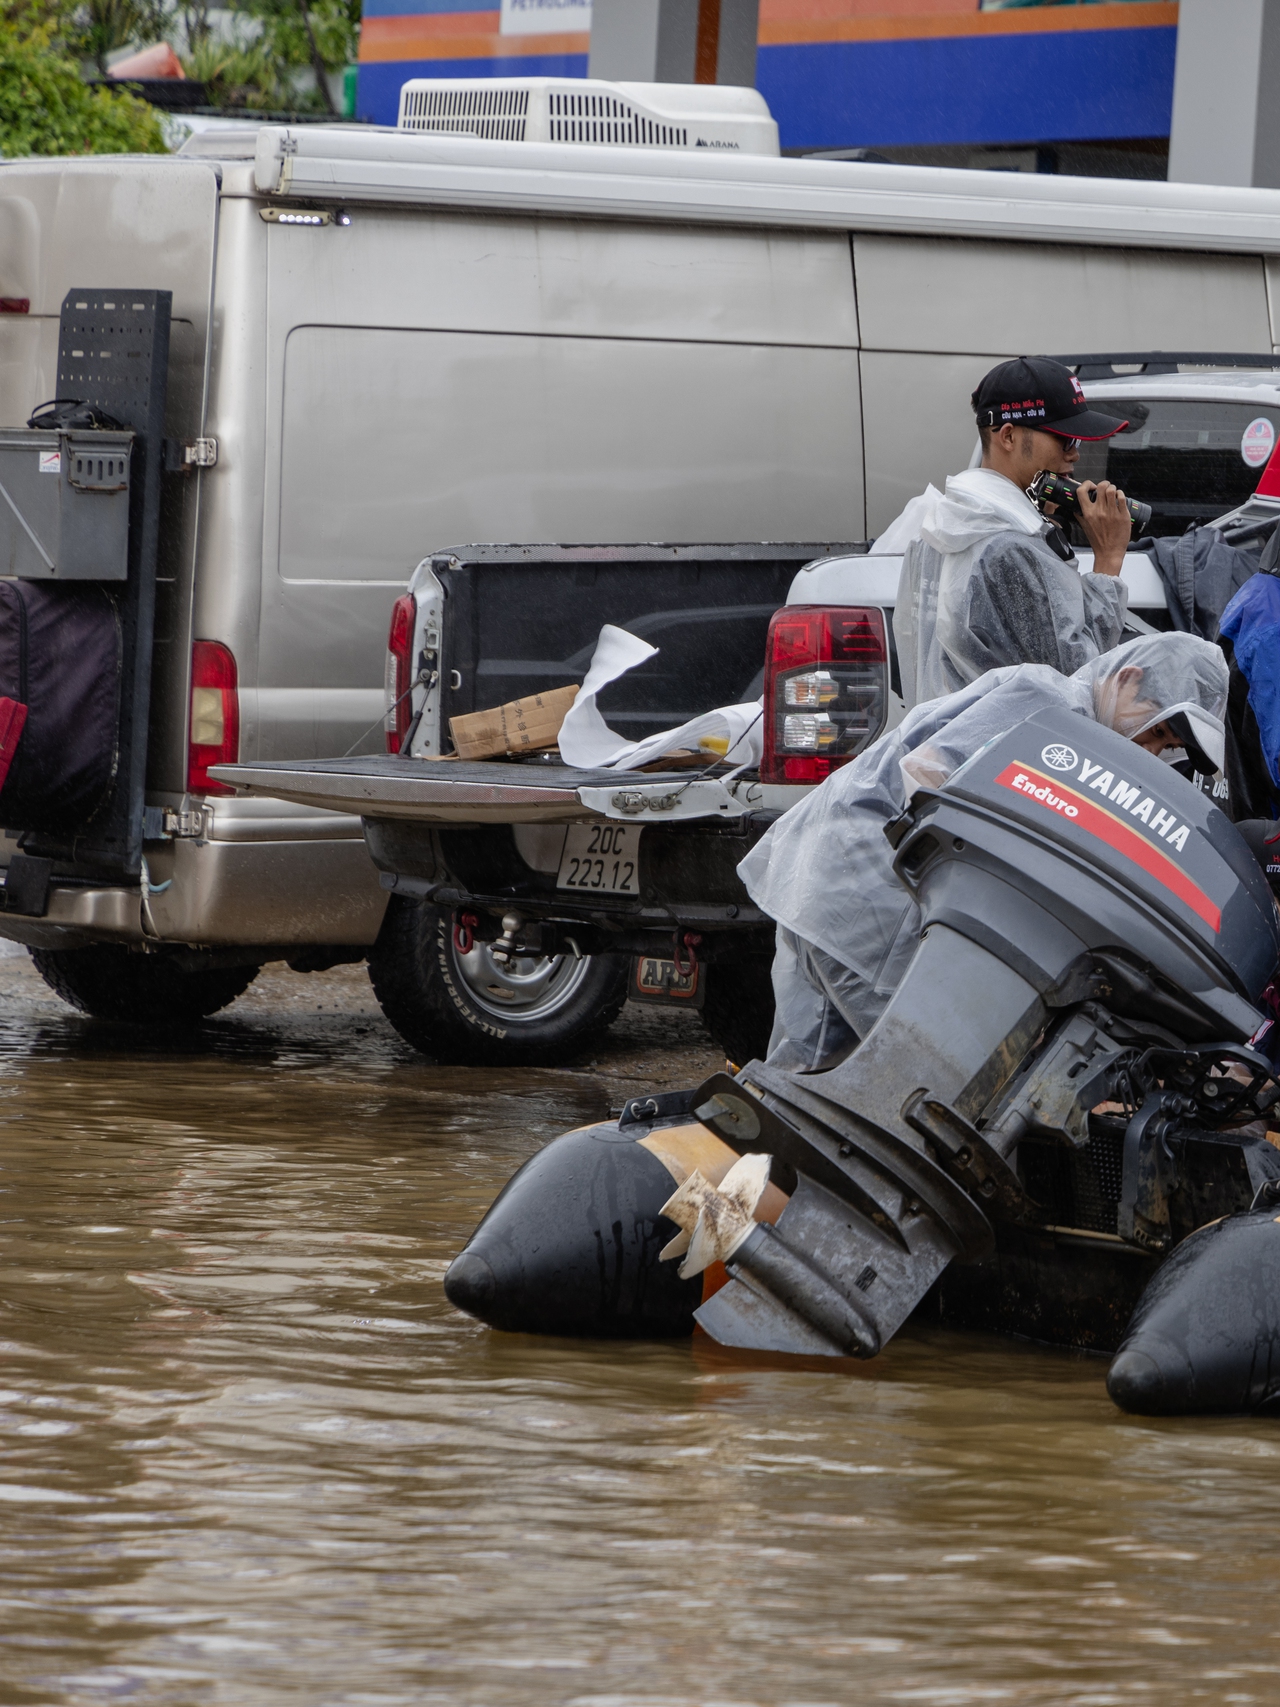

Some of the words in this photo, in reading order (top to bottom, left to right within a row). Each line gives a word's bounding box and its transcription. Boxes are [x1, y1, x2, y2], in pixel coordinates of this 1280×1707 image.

[710, 140, 740, 149] ARANA
[1011, 773, 1079, 818] Enduro
[1077, 758, 1191, 852] YAMAHA
[587, 826, 626, 854] 20C
[566, 858, 634, 890] 223.12
[1266, 865, 1280, 873] 0772
[438, 953, 508, 1040] ALL-TERRAIN
